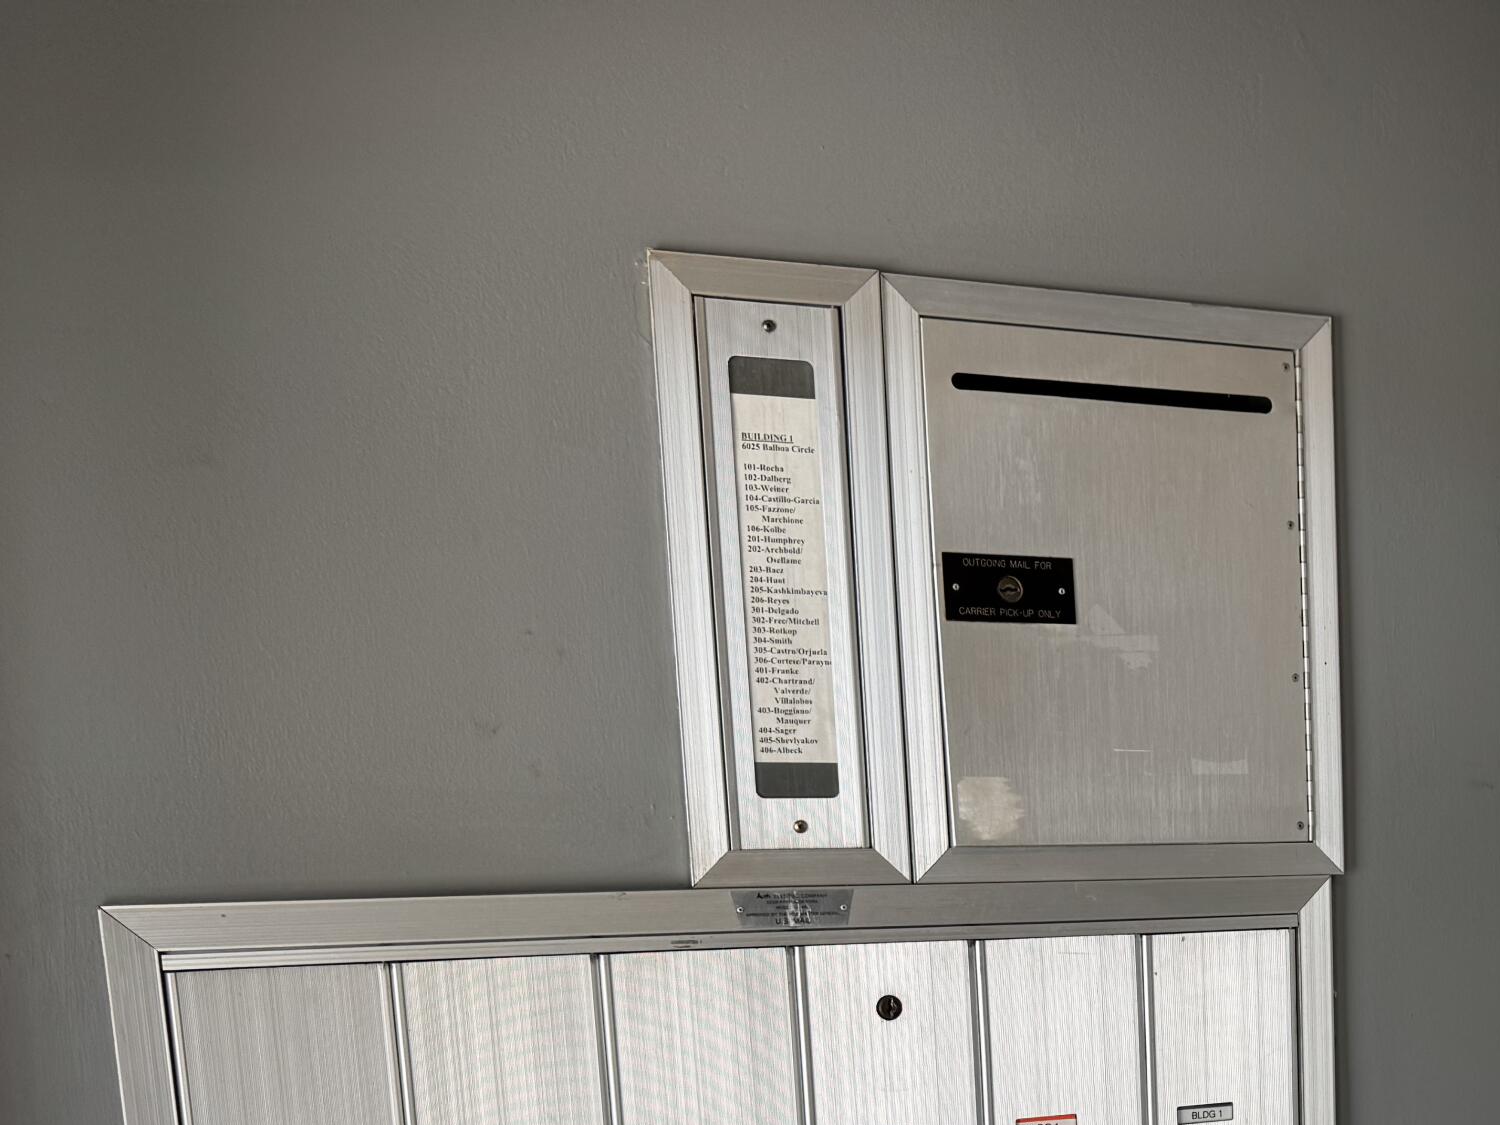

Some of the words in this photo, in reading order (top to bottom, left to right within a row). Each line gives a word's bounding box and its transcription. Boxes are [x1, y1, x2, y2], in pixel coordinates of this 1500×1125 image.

[741, 432, 787, 442] BUILDING
[741, 443, 760, 451] 6025
[763, 444, 789, 452] Balboa
[791, 445, 815, 454] Circle
[963, 558, 1006, 567] OUTGOING
[1010, 560, 1030, 569] MAIL
[1035, 561, 1051, 569] FOR
[959, 607, 996, 616] CARRIER
[1000, 609, 1033, 617] PICK-UP
[1038, 610, 1061, 618] ONLY
